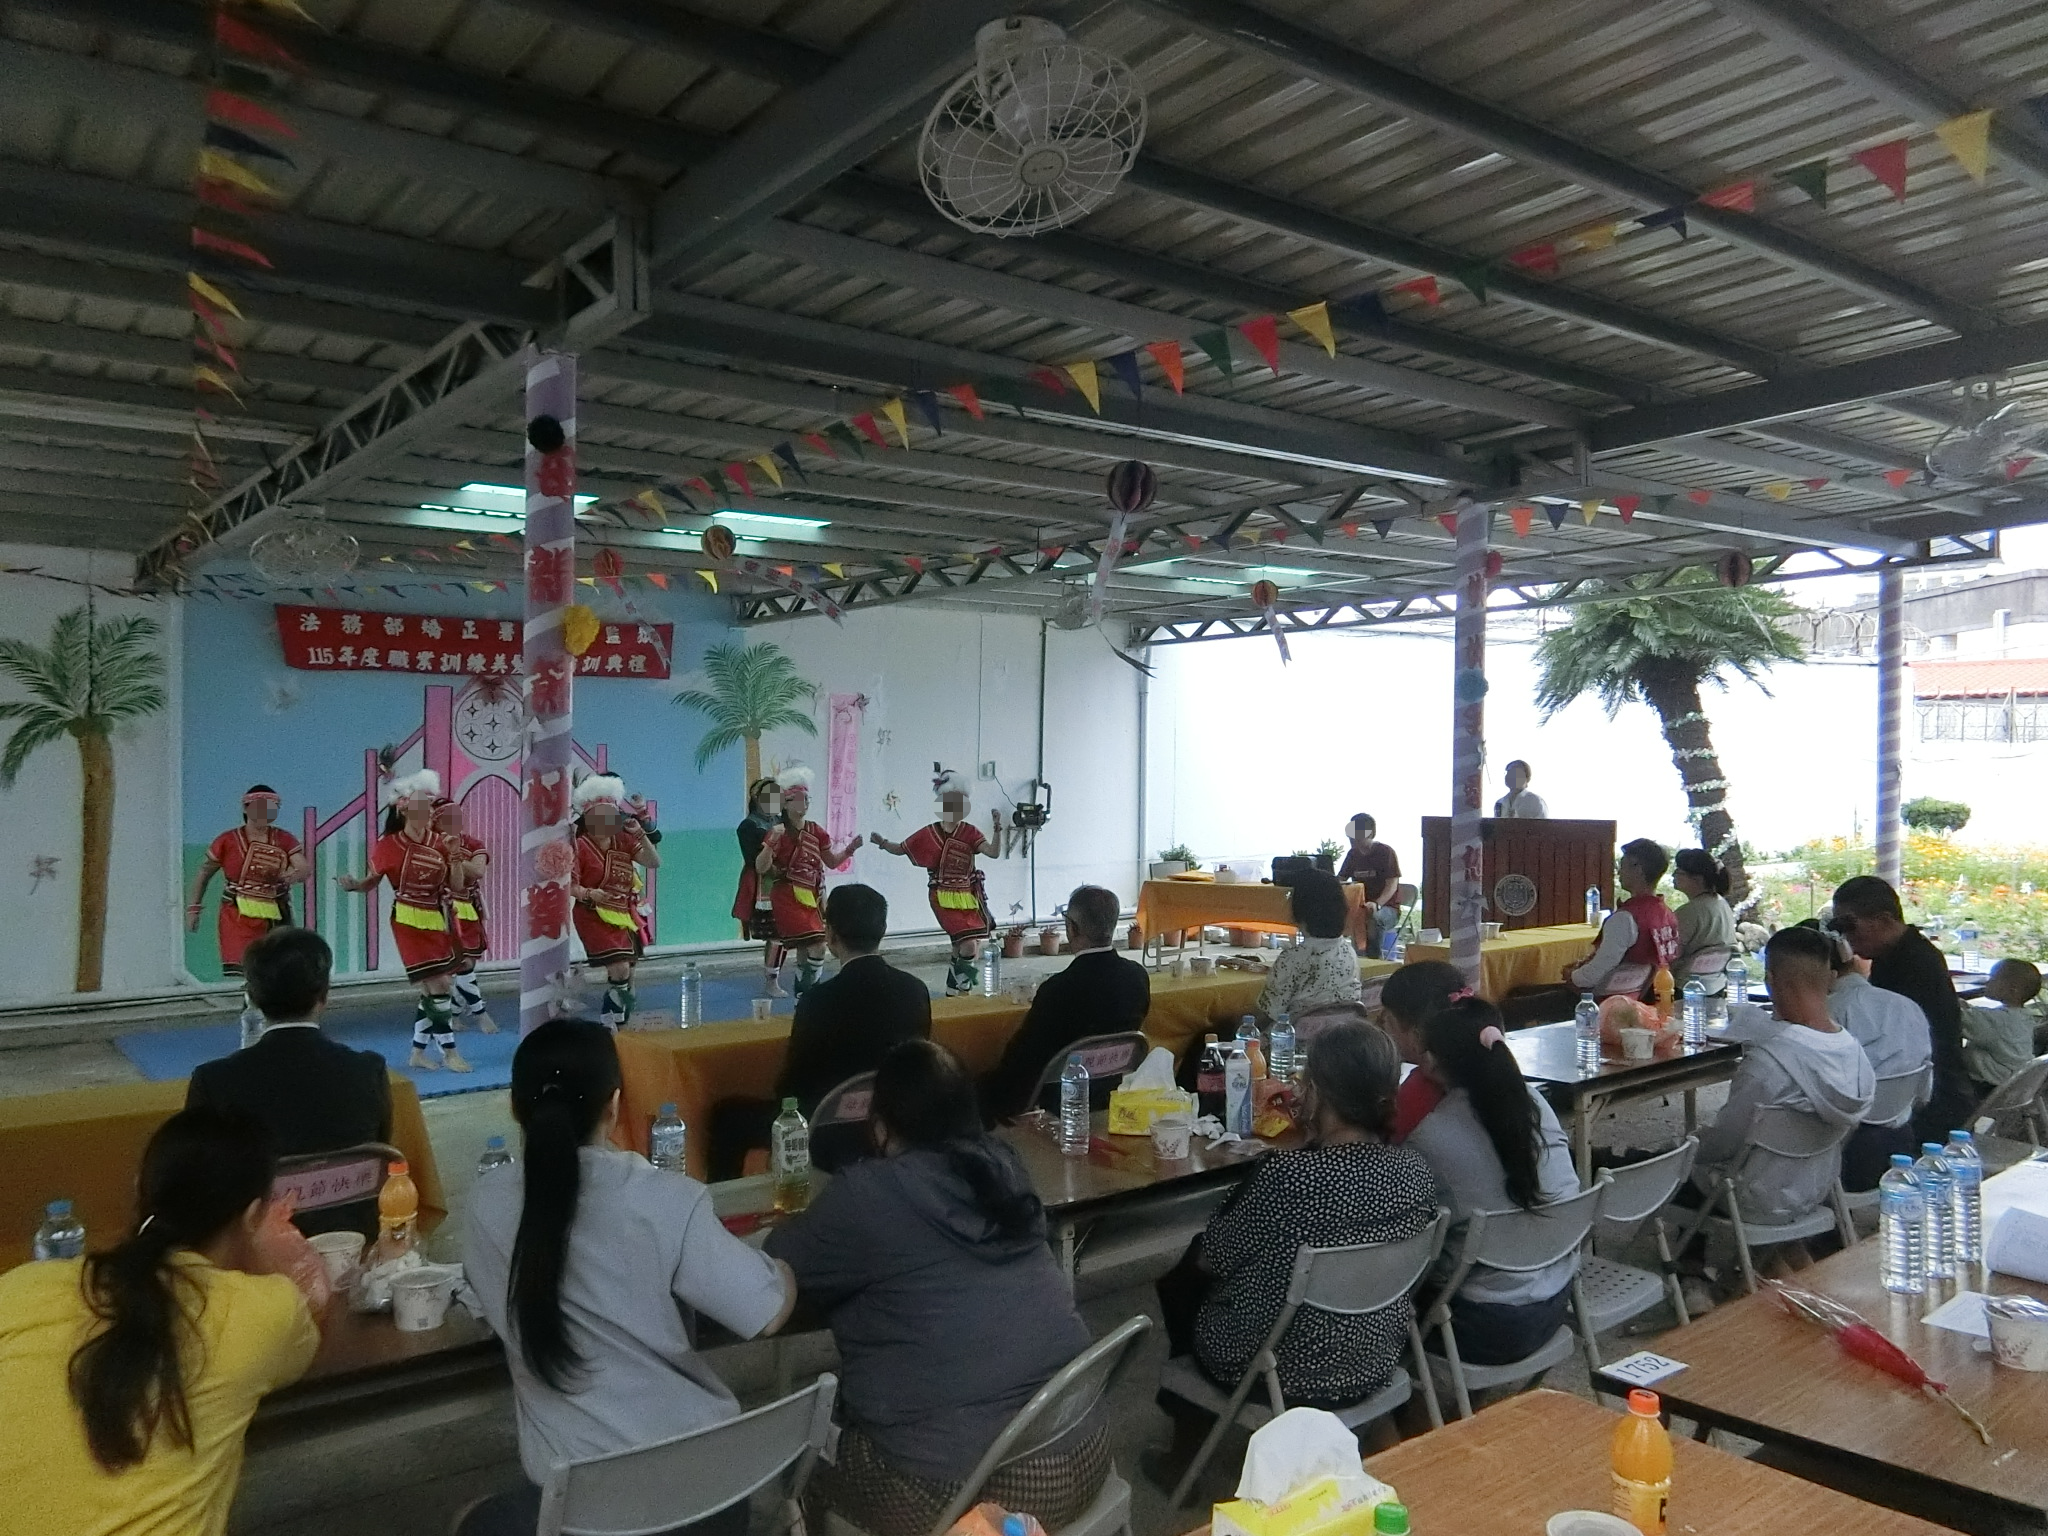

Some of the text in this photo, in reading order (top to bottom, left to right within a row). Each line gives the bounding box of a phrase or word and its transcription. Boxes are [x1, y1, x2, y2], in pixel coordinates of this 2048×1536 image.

[299, 612, 655, 644] 法務部矯正署監獄
[1616, 1356, 1670, 1378] 1752
